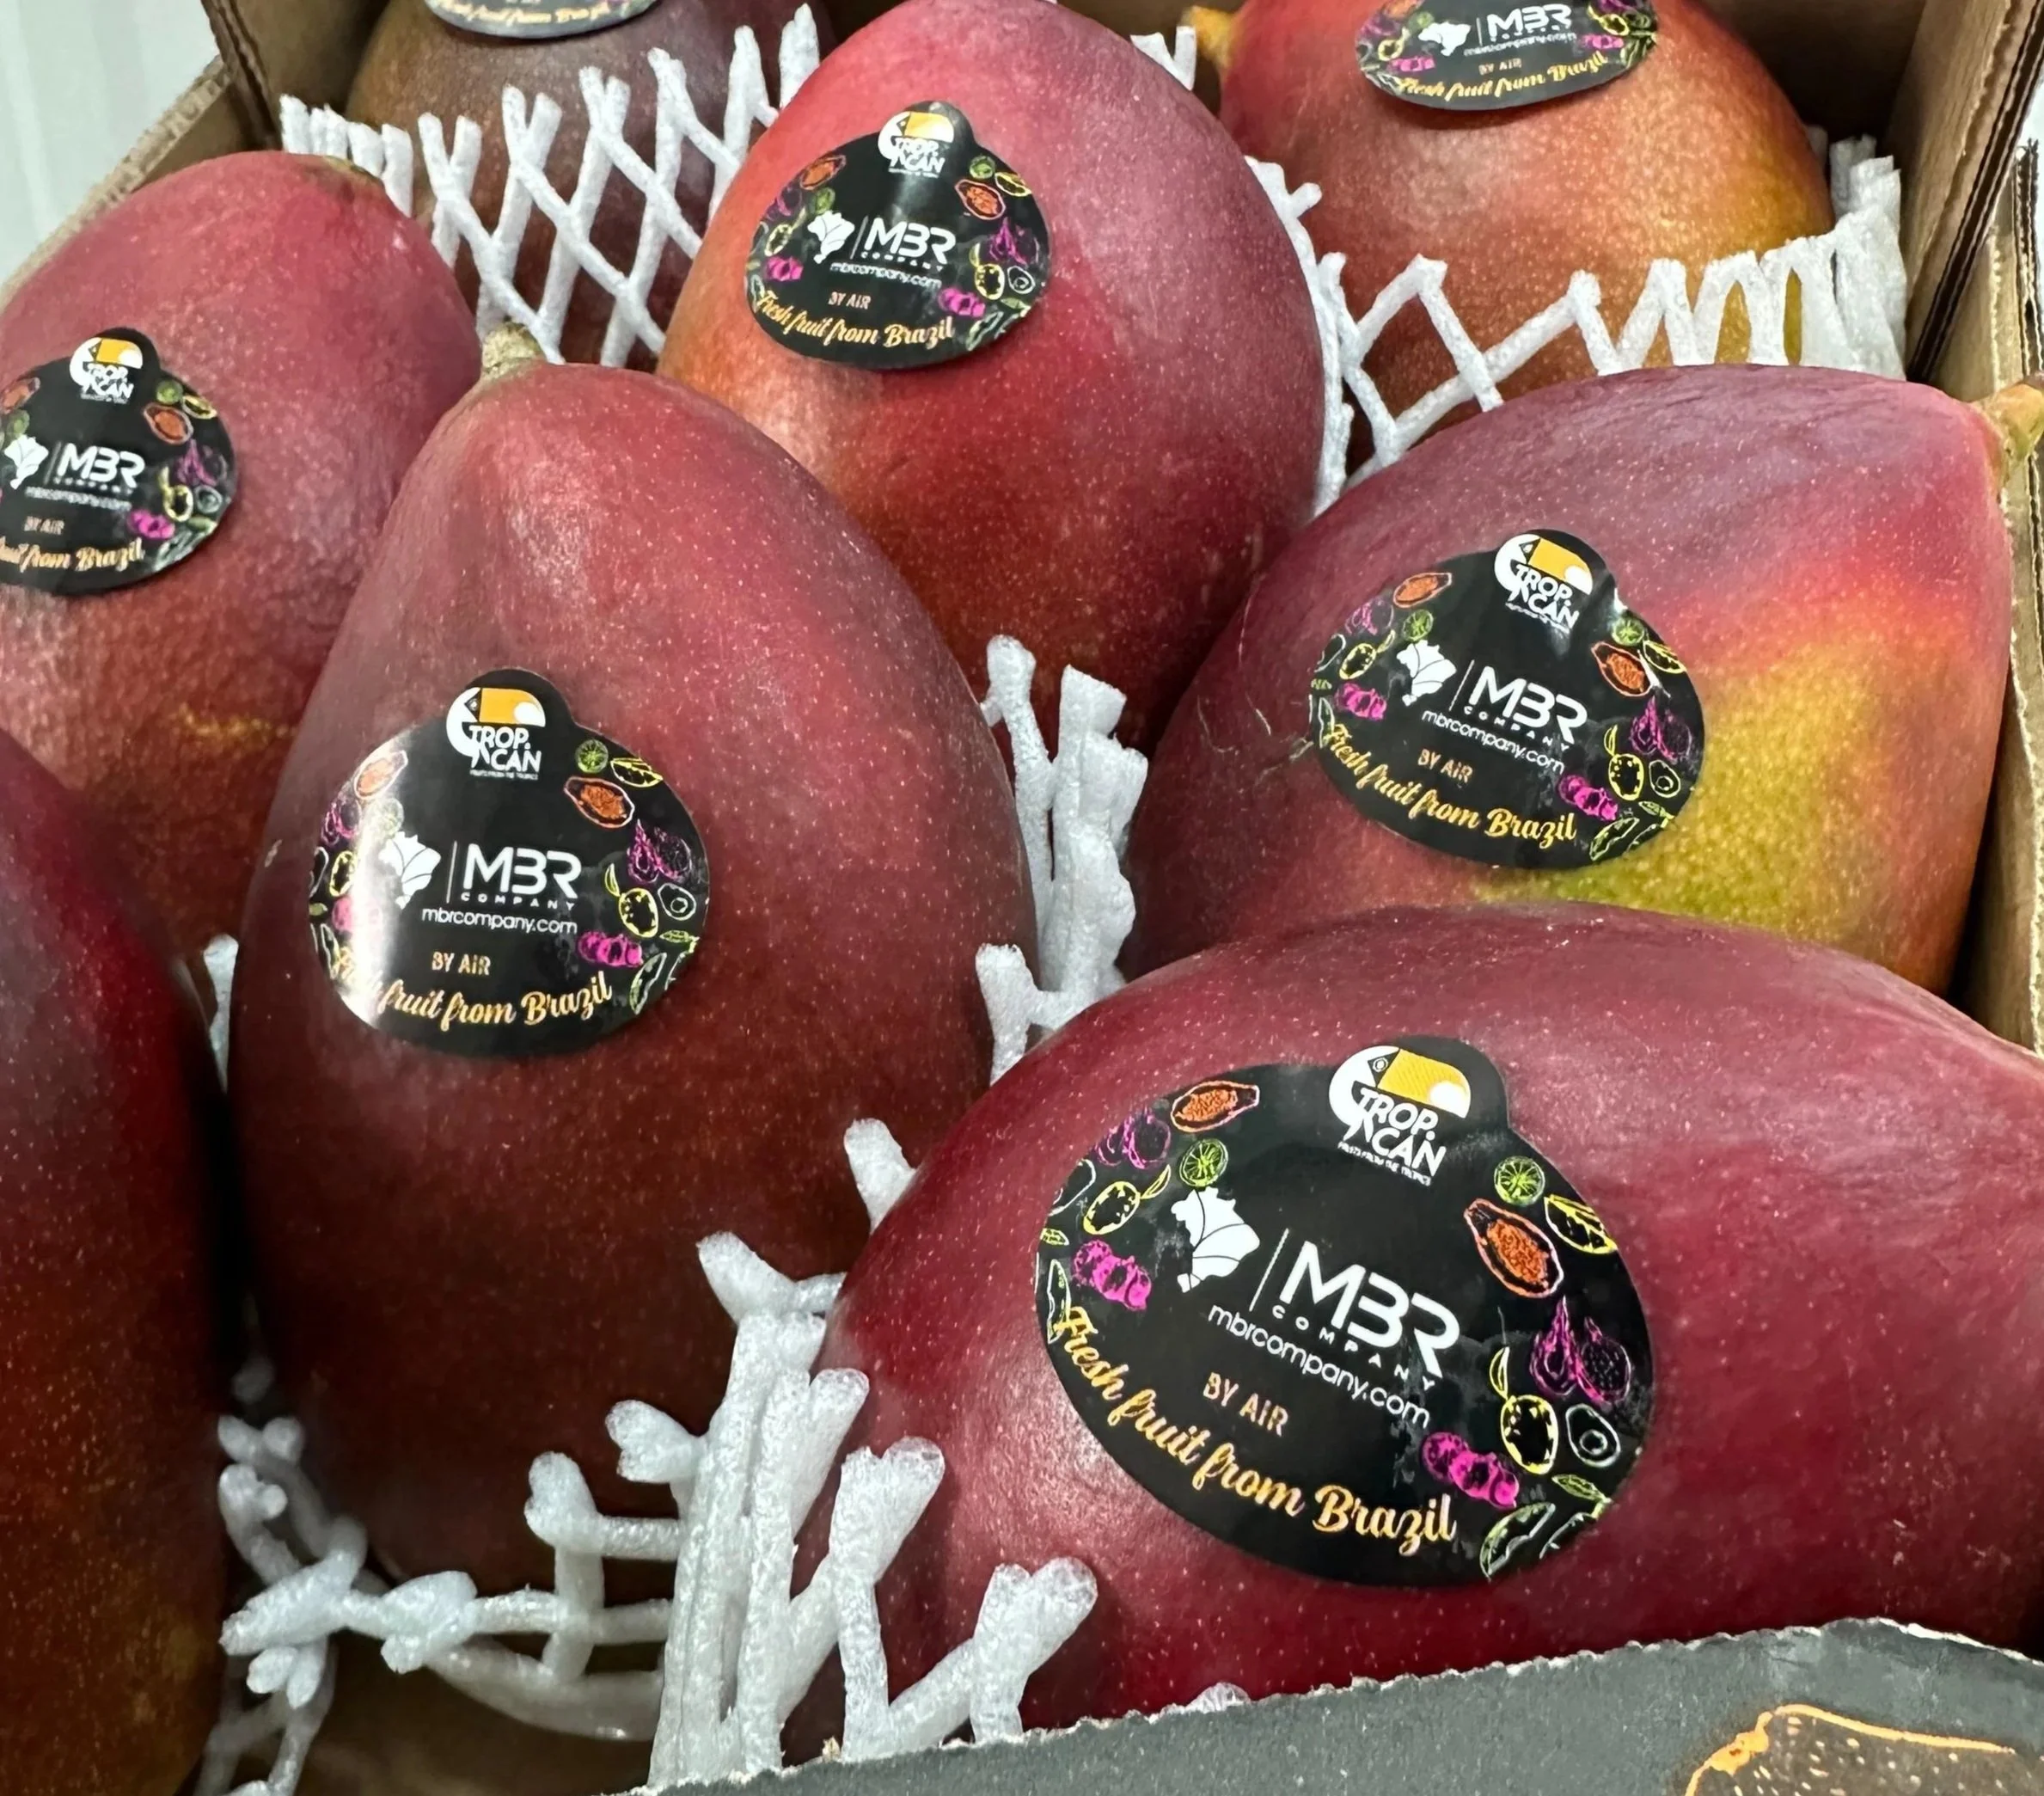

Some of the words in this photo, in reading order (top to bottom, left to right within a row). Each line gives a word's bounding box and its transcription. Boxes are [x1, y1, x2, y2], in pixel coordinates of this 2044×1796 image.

[1487, 3, 1572, 38] MBR
[864, 218, 957, 264] MBR
[846, 293, 872, 310] AIR
[824, 318, 878, 346] from
[883, 316, 955, 348] Brazil
[57, 442, 146, 489] MBR
[1464, 705, 1570, 752] COMPANY
[1468, 665, 1588, 745] MBR
[1417, 748, 1438, 770] BY
[1441, 759, 1472, 783] AIR
[1422, 708, 1564, 774] mbrcompany.com
[1326, 722, 1370, 776] Fresh
[1360, 765, 1416, 806] fruit
[1408, 791, 1480, 830] from
[1484, 808, 1577, 849] Brazil
[462, 843, 583, 899] MBR
[422, 908, 578, 935] mbrcompany.com
[460, 892, 575, 911] COMPANY
[431, 951, 455, 972] BY
[458, 953, 492, 976] AIR
[440, 992, 516, 1032] from
[520, 971, 613, 1027] Brazil
[1279, 1240, 1460, 1380] MBR
[1209, 1303, 1430, 1430] mbrcompany.com
[1273, 1304, 1436, 1392] COMPANY
[1203, 1371, 1239, 1412] BY
[1239, 1391, 1289, 1437] AIR
[1054, 1305, 1132, 1403] Fresh
[1107, 1388, 1203, 1469] fruit
[1192, 1445, 1305, 1517] from
[1312, 1483, 1457, 1556] Brazil
